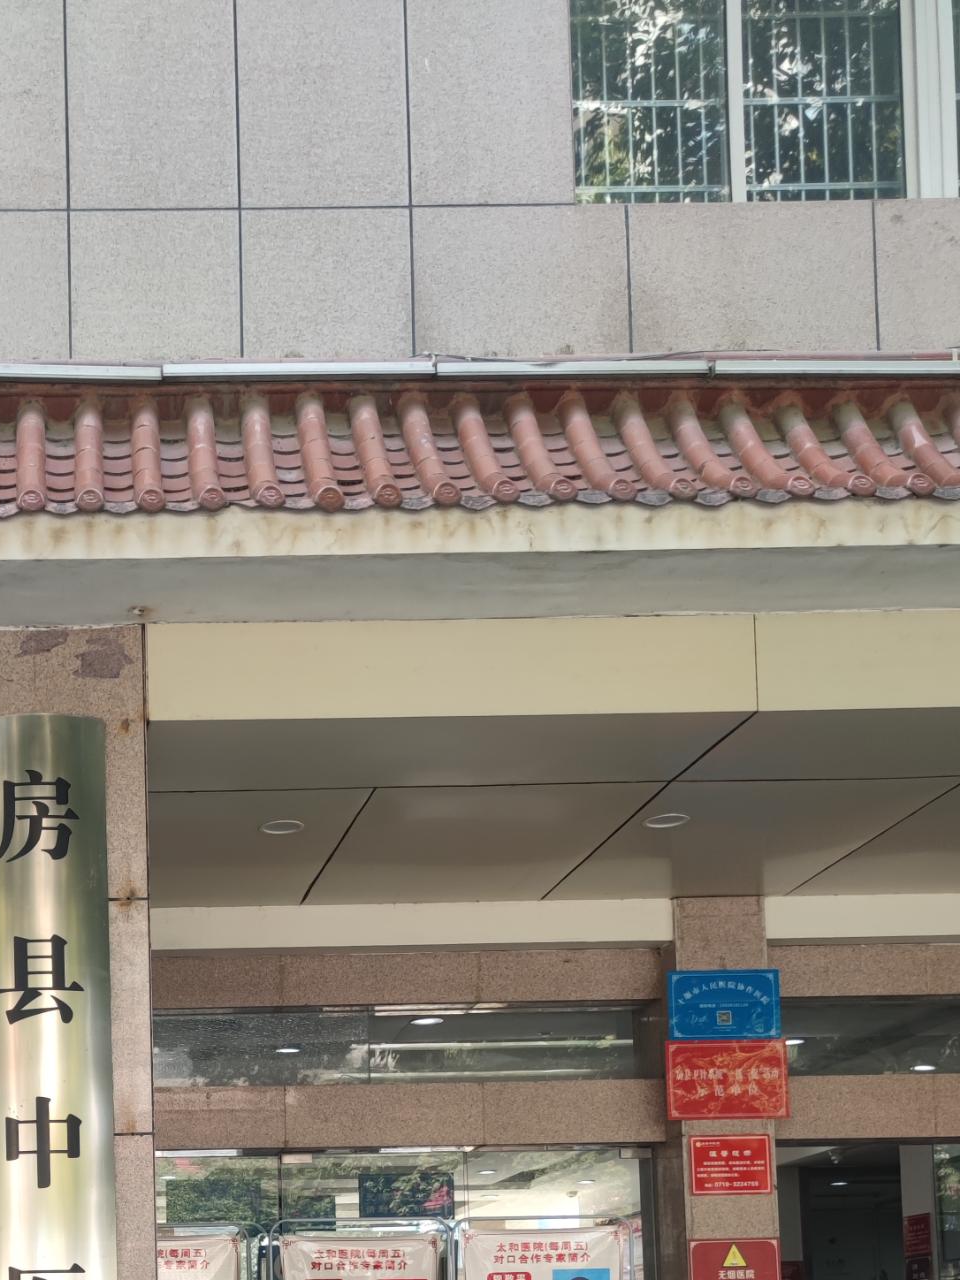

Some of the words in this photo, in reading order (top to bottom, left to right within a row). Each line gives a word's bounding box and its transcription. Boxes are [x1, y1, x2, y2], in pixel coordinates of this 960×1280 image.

[493, 1252, 591, 1265] 对口合作专家简介
[718, 1270, 755, 1280] 无烟医院
